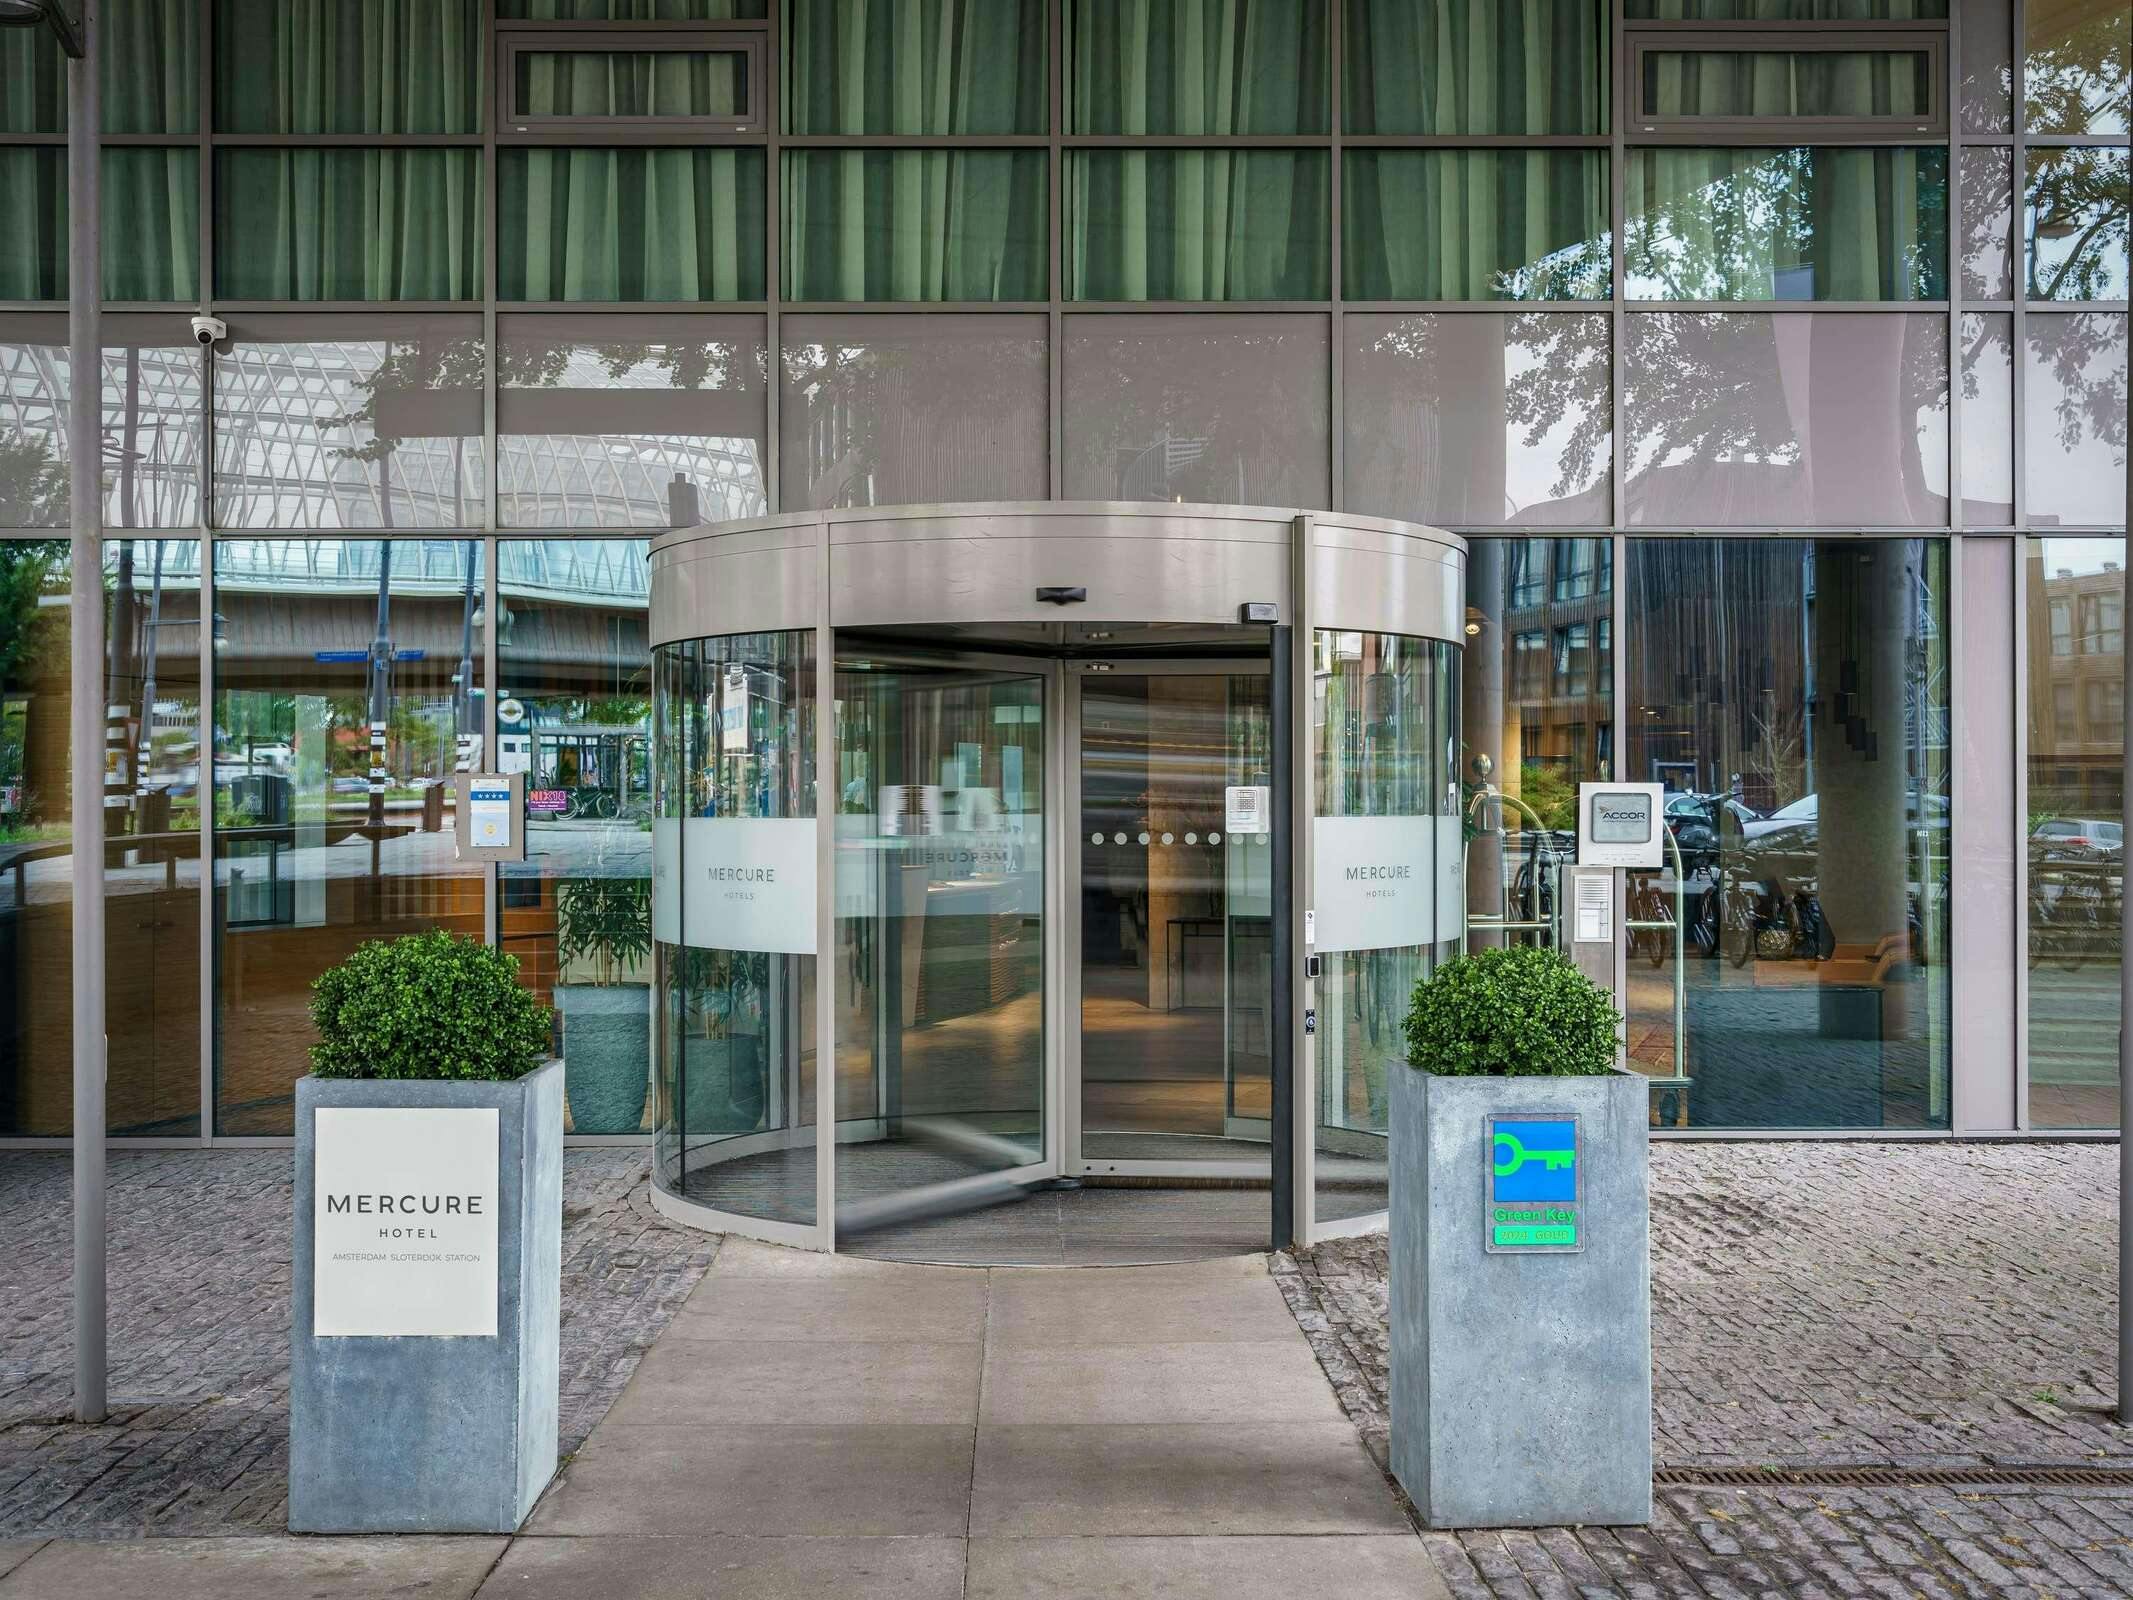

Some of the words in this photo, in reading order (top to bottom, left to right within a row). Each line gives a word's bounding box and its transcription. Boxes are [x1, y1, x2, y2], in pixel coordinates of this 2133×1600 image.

[708, 868, 775, 882] MERCURE
[1346, 865, 1411, 880] MERCURE
[724, 892, 754, 901] HOTELS
[1366, 890, 1396, 898] HOTELS
[327, 1194, 483, 1215] MERCURE
[1494, 1208, 1541, 1222] Green
[1546, 1208, 1576, 1225] Key
[379, 1228, 437, 1239] HOTEL
[332, 1253, 387, 1262] AMSTERDAM
[444, 1254, 481, 1263] STATION
